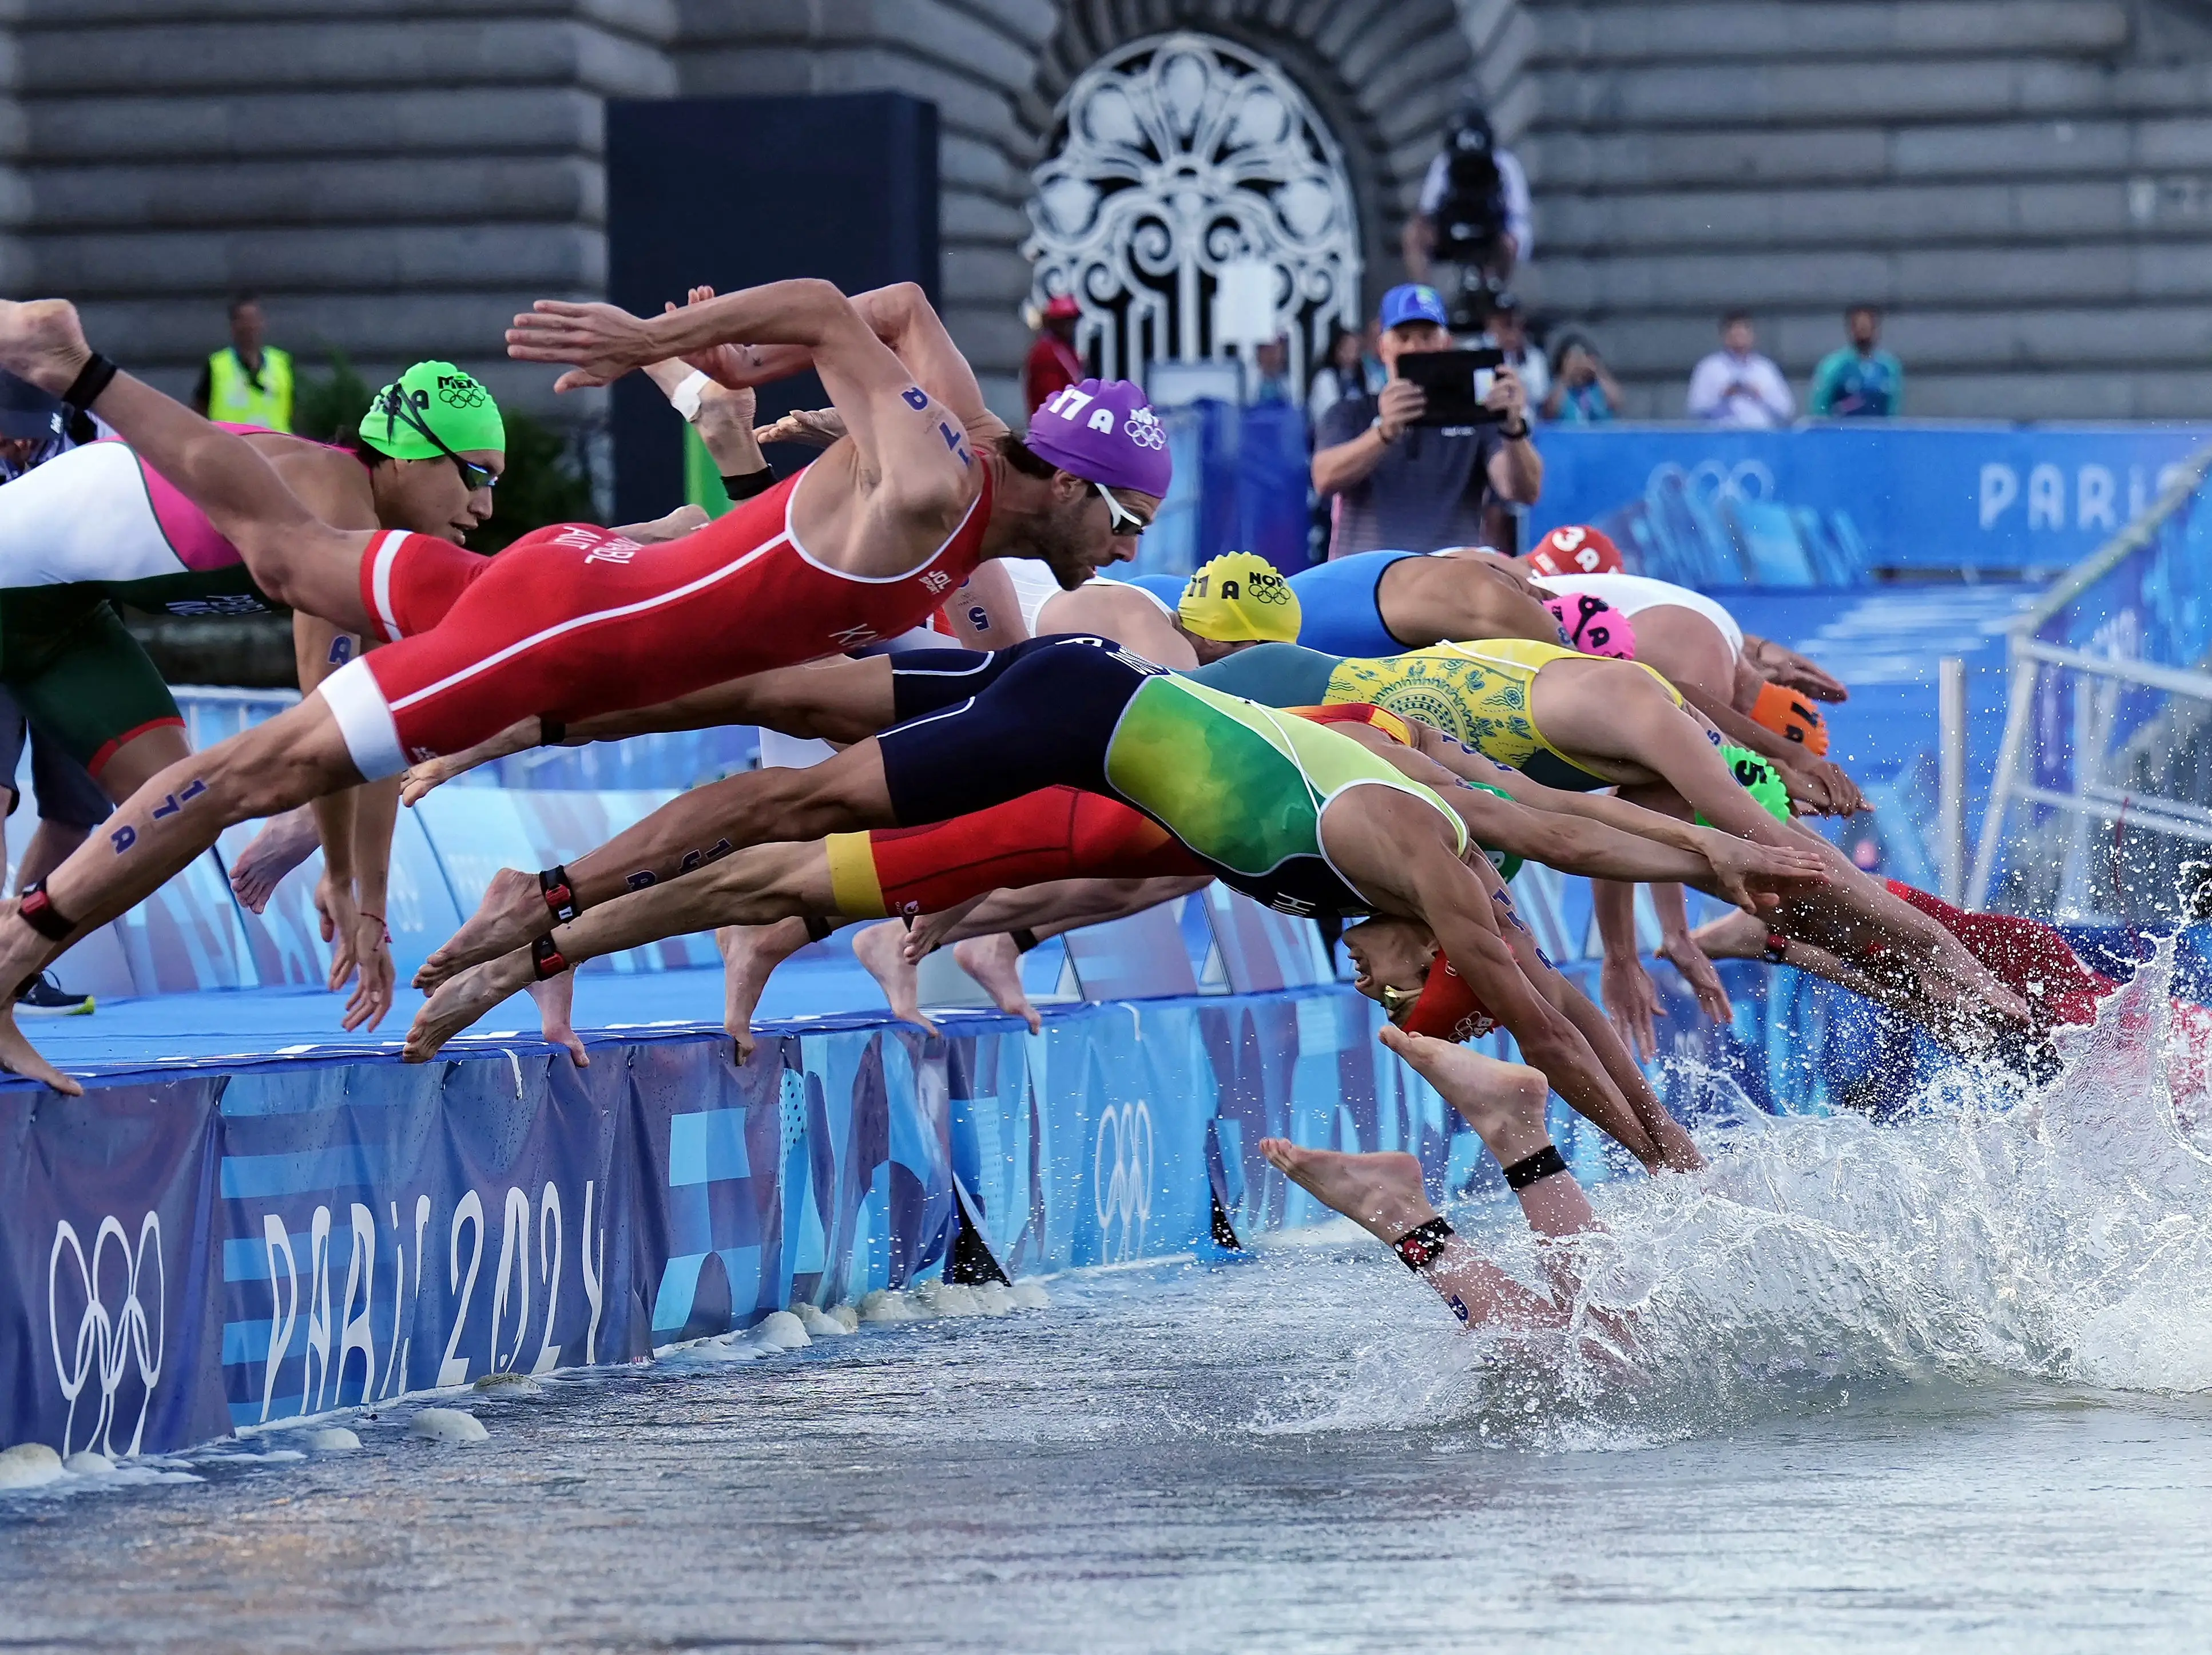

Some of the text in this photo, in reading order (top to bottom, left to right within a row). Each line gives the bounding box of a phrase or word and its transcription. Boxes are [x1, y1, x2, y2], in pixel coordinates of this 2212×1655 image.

[899, 387, 928, 411] A
[1048, 388, 1094, 421] 17
[1087, 408, 1115, 435] A
[1551, 526, 1601, 573] 3 A
[1221, 580, 1240, 600] A
[1587, 626, 1610, 649] A
[1734, 760, 1768, 787] 5
[110, 780, 206, 855] 17 A
[260, 1180, 604, 1423] PARIS 2024
